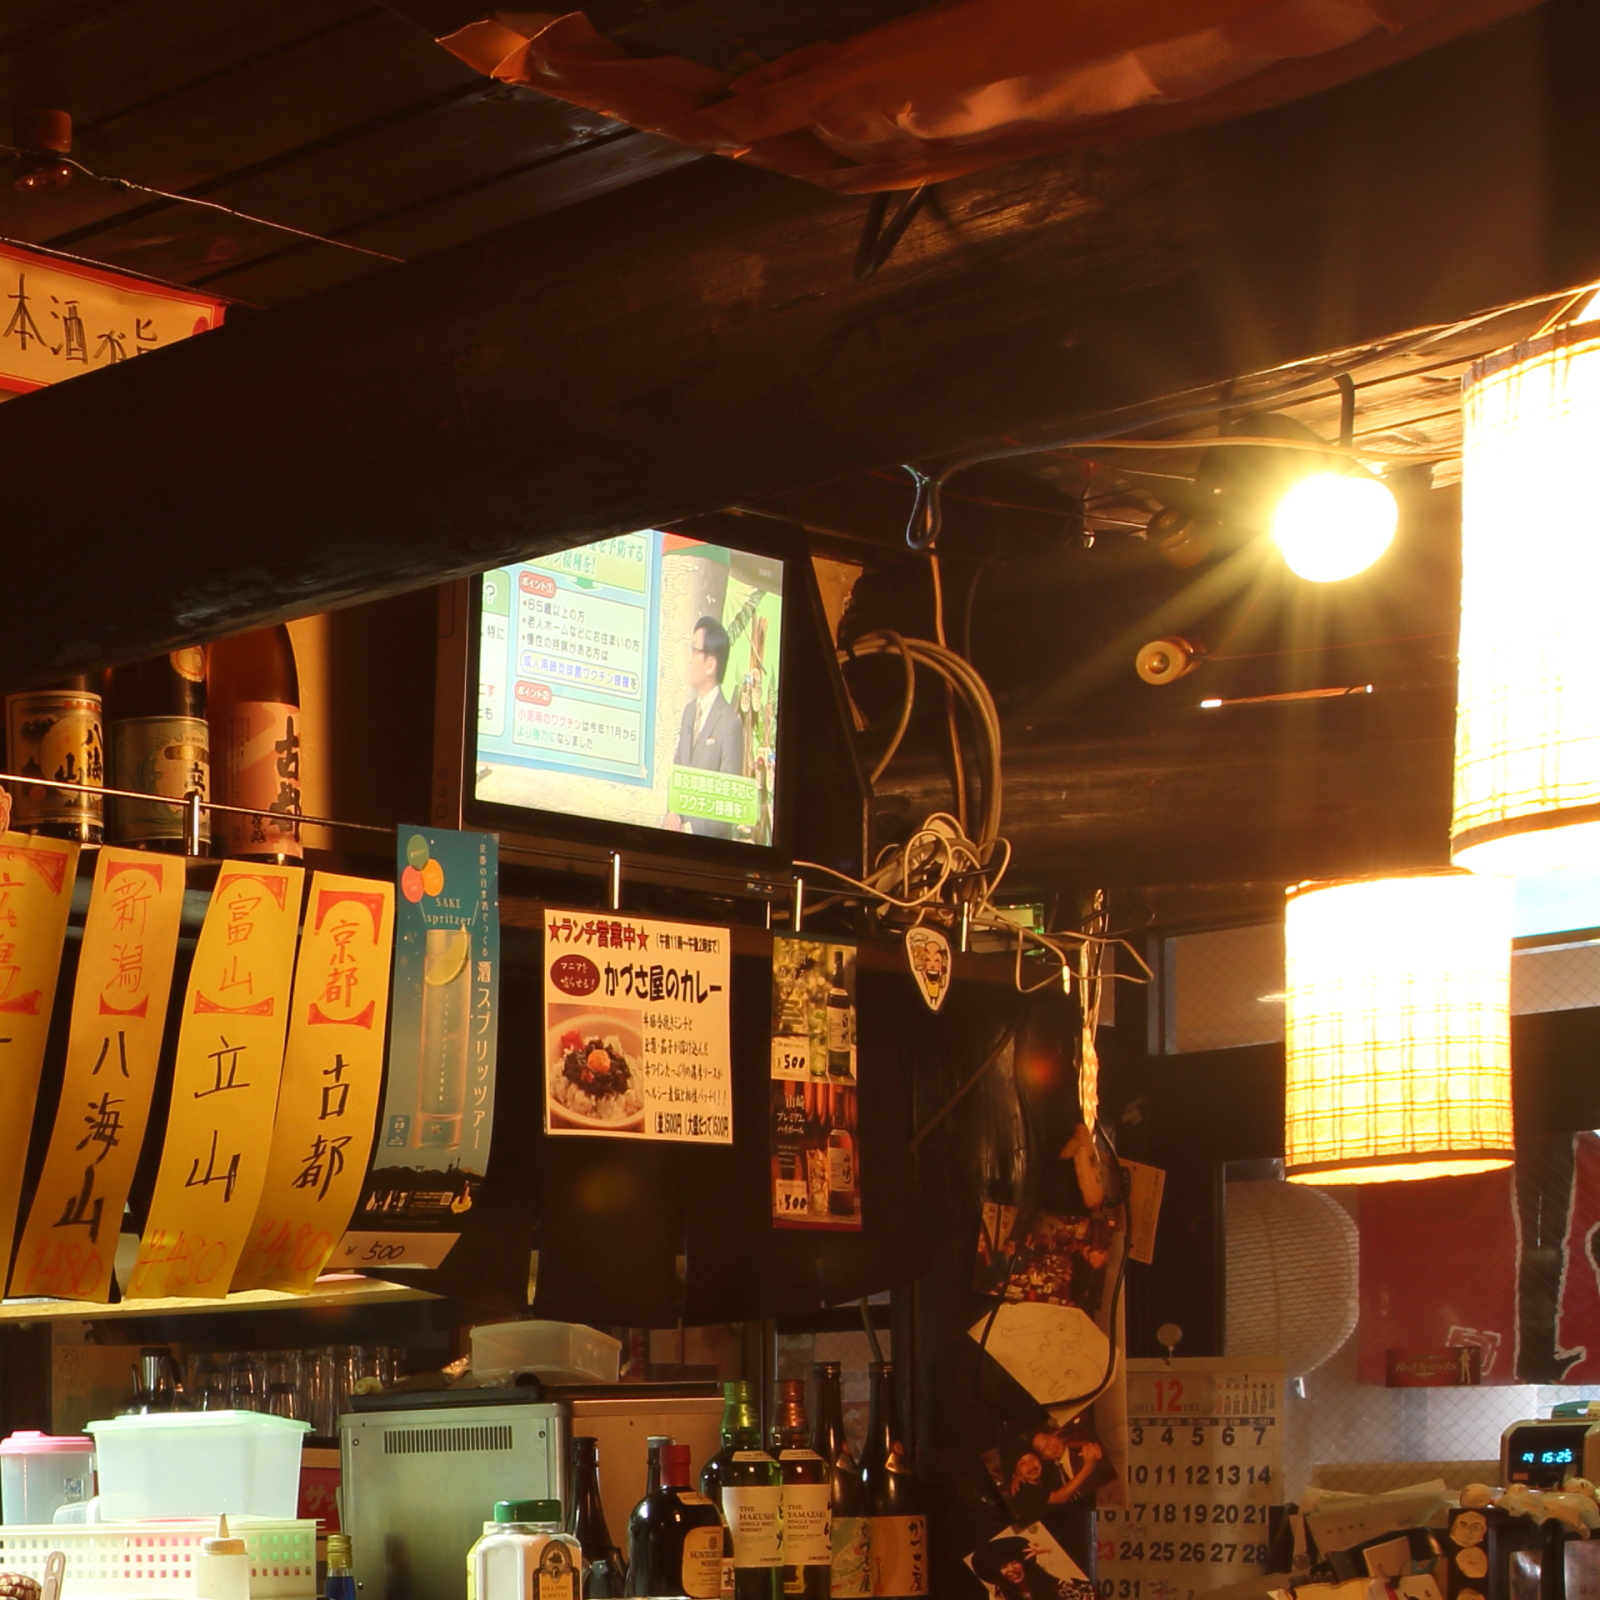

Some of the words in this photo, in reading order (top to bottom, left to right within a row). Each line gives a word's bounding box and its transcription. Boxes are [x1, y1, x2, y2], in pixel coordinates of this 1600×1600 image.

[527, 615, 640, 652] 老人ホームなどにお住まいの方
[526, 633, 608, 661] 慢性の持病がある方は
[523, 655, 638, 690] 成人用肺炎球菌ワクチン接種を
[516, 724, 594, 750] より強力になりました
[518, 707, 637, 741] 小児用のワクチンは今年11月から
[435, 897, 461, 909] SAKE
[427, 913, 473, 926] spritzer
[106, 877, 152, 994] 新潟
[220, 893, 261, 995] 富山
[323, 918, 360, 1008] 京都
[604, 961, 723, 1004] かづさ屋のカレー
[472, 960, 492, 1149] 酒スプリッツァー
[784, 1053, 806, 1070] 500
[185, 1034, 250, 1203] 立山
[291, 1054, 353, 1202] 古都
[53, 1030, 129, 1245] 八海山
[785, 1194, 807, 1210] 500
[361, 1243, 405, 1261] 500
[1152, 1379, 1184, 1413] 12
[1130, 1427, 1144, 1446] 3
[1160, 1427, 1174, 1446] 4
[1191, 1427, 1204, 1446] 5
[1221, 1427, 1235, 1446] 6
[1253, 1427, 1266, 1446] 7
[1541, 1450, 1573, 1464] 15:25
[1127, 1465, 1148, 1485] 10
[1154, 1465, 1176, 1485] 11
[1184, 1465, 1209, 1485] 12
[1215, 1465, 1240, 1485] 13
[1246, 1465, 1271, 1485] 14
[739, 1505, 756, 1513] THE
[786, 1503, 803, 1511] THE
[786, 1510, 827, 1519] YAMAZAKI
[1124, 1503, 1146, 1523] 17
[1152, 1503, 1177, 1523] 18
[1182, 1503, 1207, 1523] 19
[1212, 1503, 1239, 1523] 20
[1243, 1503, 1267, 1523] 21
[908, 1519, 924, 1592] かづさ屋
[1119, 1541, 1145, 1562] 24
[1149, 1541, 1174, 1562] 25
[1179, 1541, 1205, 1562] 26
[1210, 1541, 1237, 1562] 27
[1242, 1541, 1268, 1562] 28
[1118, 1579, 1141, 1599] 31
